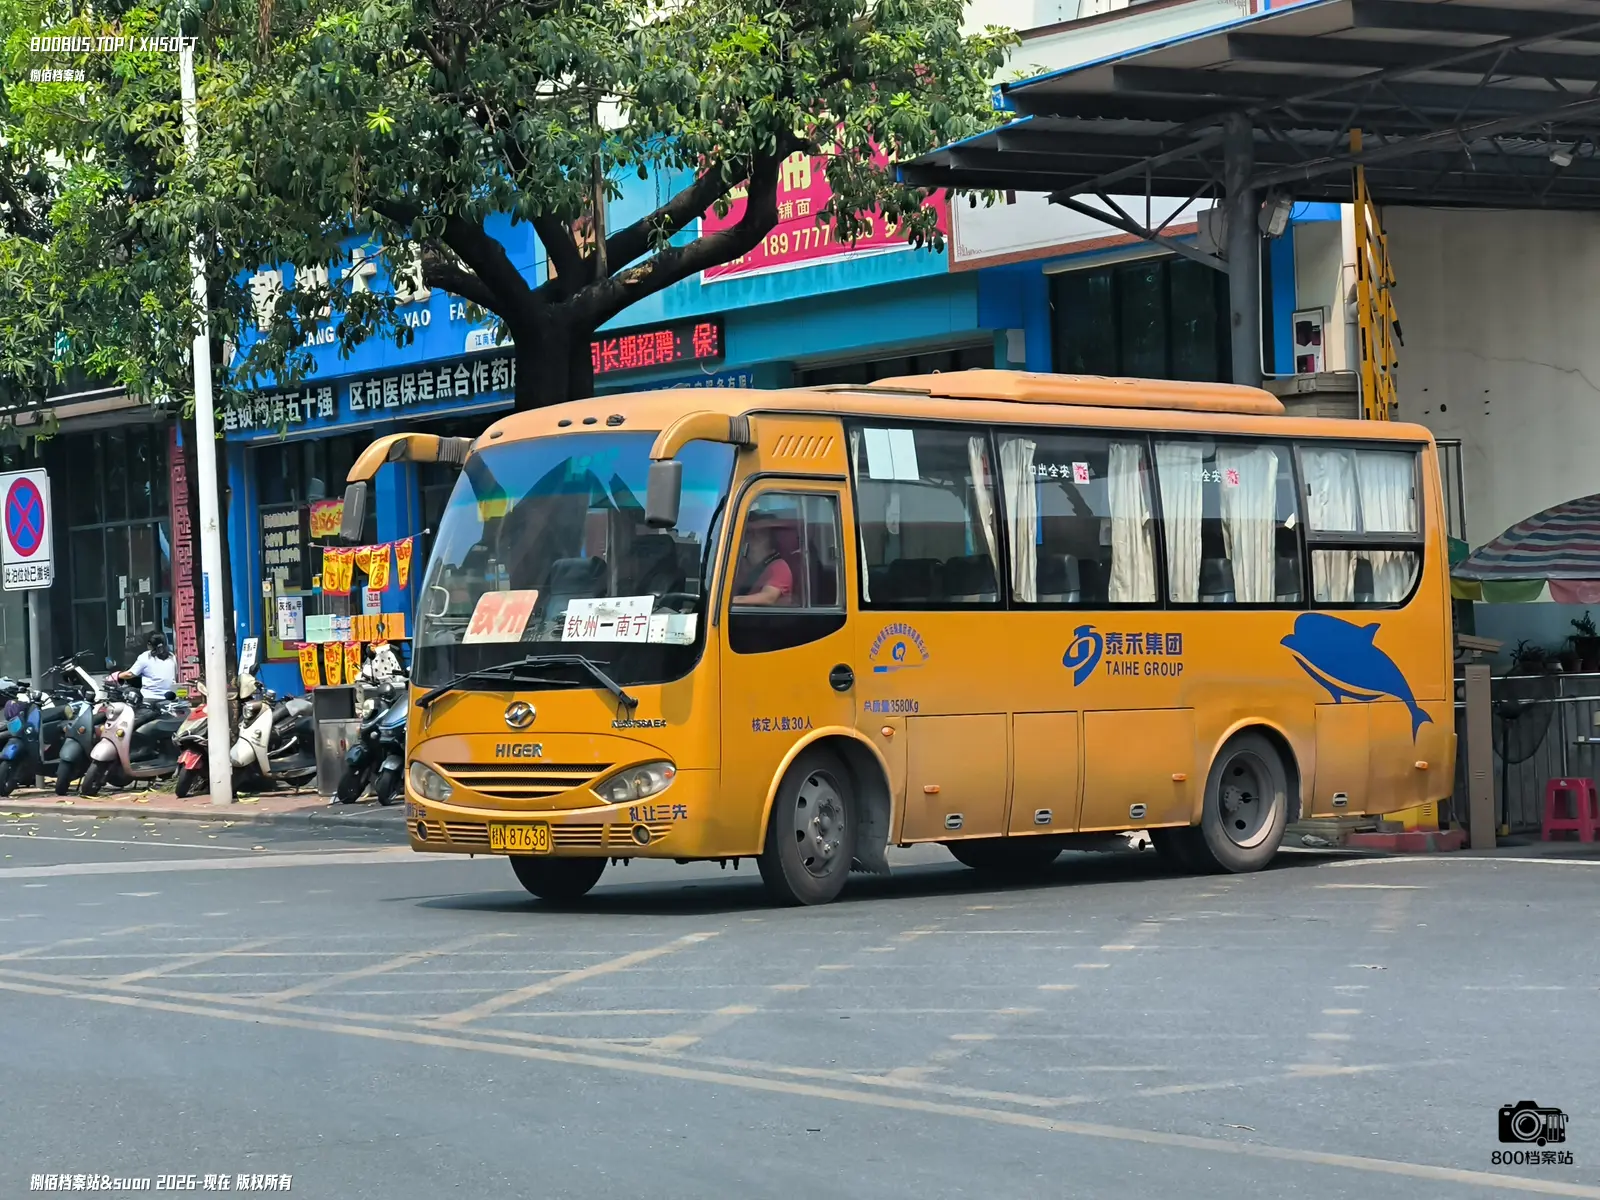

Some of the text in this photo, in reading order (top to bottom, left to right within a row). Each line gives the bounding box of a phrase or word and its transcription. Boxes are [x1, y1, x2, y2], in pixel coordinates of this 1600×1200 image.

[403, 309, 432, 328] YAO
[1105, 632, 1182, 655] 泰禾集团
[1106, 661, 1184, 676] TAIHE GROUP
[752, 716, 813, 732] 核定人数30人
[496, 743, 543, 758] HIGER
[629, 804, 688, 822] 礼让三先
